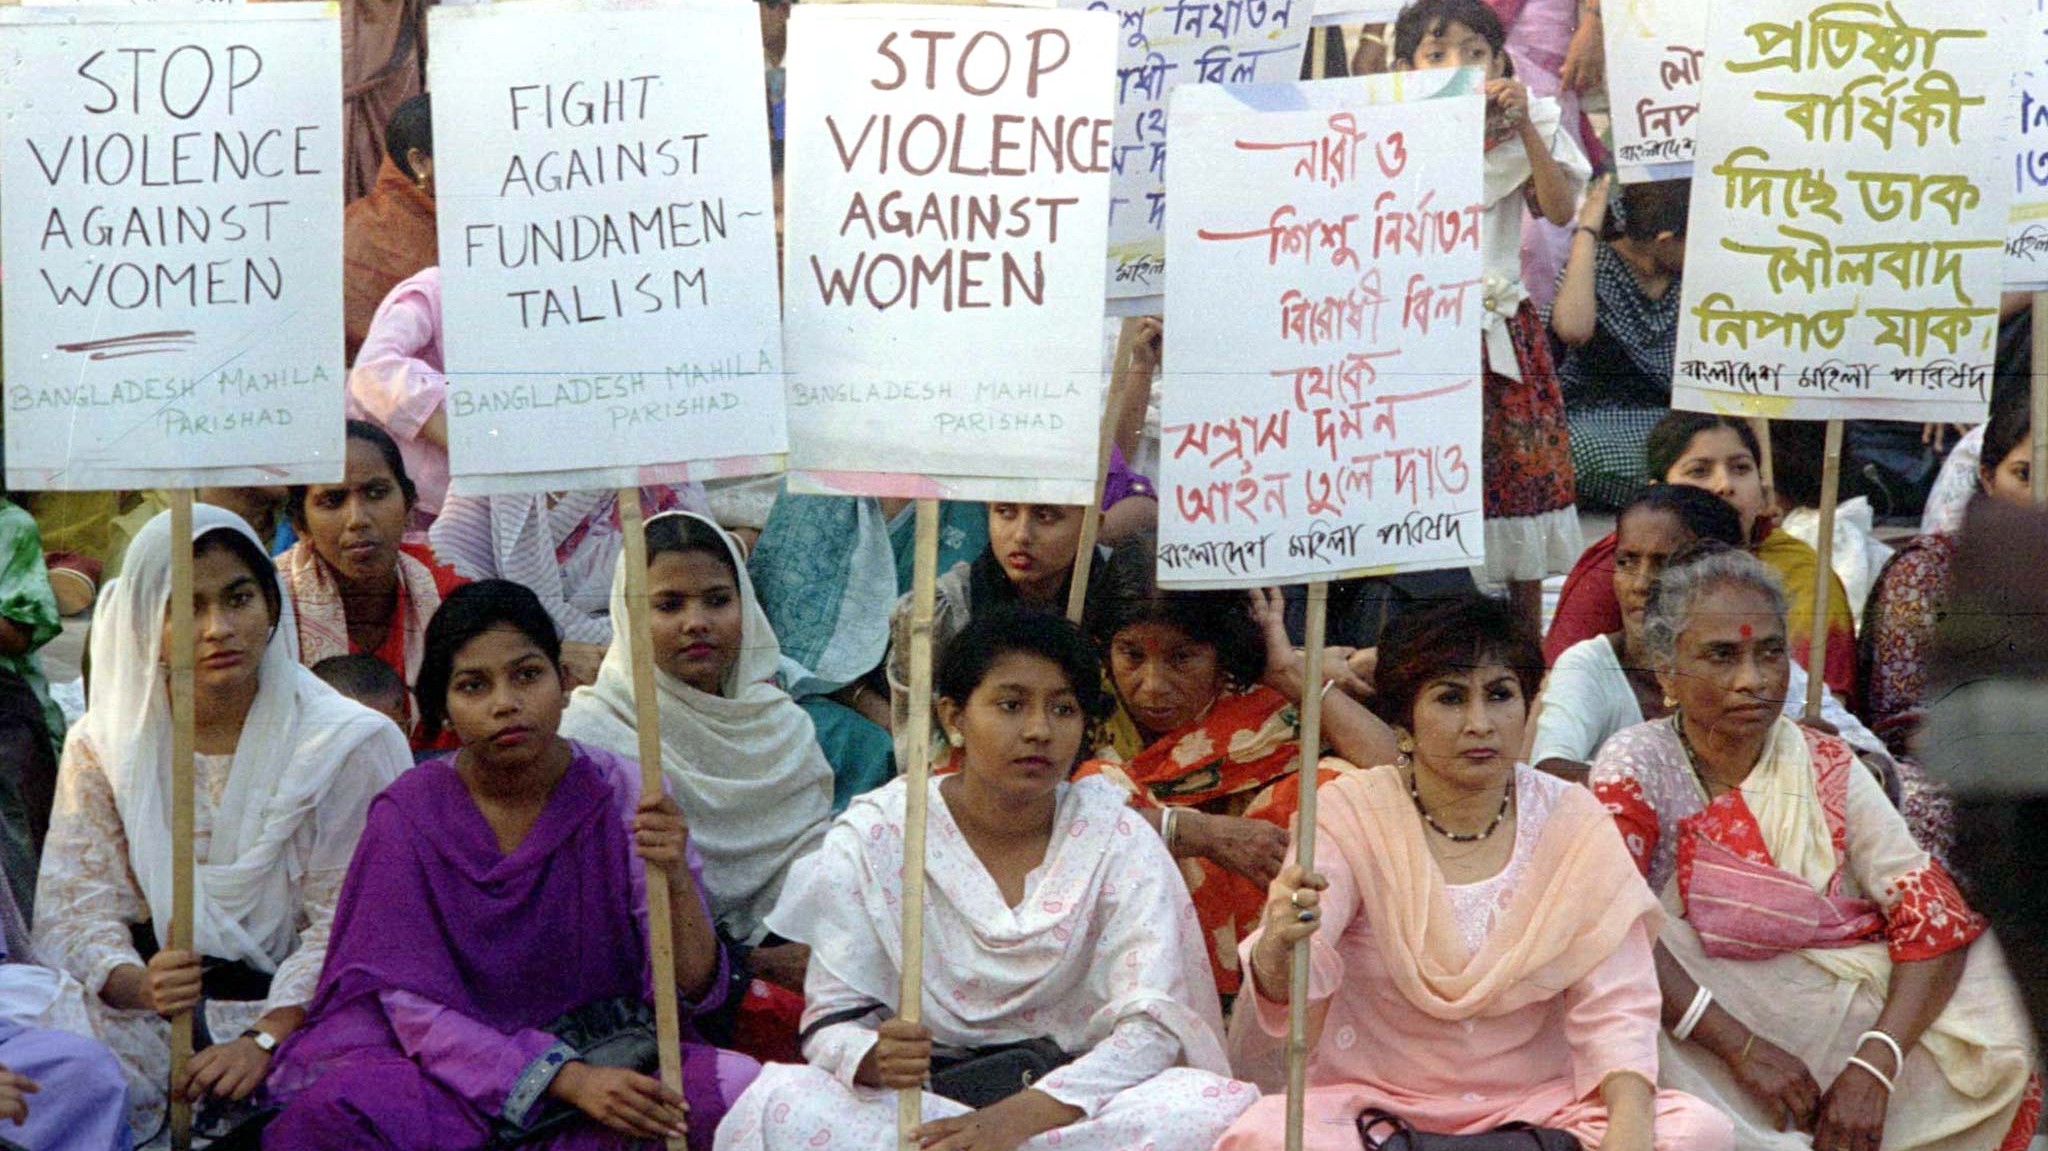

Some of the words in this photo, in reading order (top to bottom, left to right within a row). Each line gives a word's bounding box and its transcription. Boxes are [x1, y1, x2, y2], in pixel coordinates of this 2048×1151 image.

[869, 28, 1070, 98] STOP
[1725, 1, 1987, 73] প্রতিষ্ঠা
[78, 44, 262, 119] STOP
[509, 75, 661, 131] FIGHT
[1754, 69, 1985, 150] বার্ষিকী
[26, 126, 321, 186] VIOLENCE
[499, 133, 708, 197] AGAINST
[825, 113, 1112, 176] VIOLENCE
[1234, 112, 1367, 188] নারী
[1376, 131, 1408, 178] ও
[40, 200, 290, 250] AGAINST
[840, 190, 1079, 243] AGAINST
[1845, 170, 1981, 225] ডাক
[1197, 204, 1360, 271] শিশু
[1374, 189, 1488, 258] নির্যাতন
[40, 257, 282, 309] WOMEN
[809, 247, 1045, 312] WOMEN
[1720, 224, 2004, 307] মৌলবাদ
[507, 268, 708, 328] TALISM
[1280, 268, 1390, 345] বিরোধী
[1402, 273, 1484, 334] বিল
[1690, 292, 1858, 350] নিপাত
[9, 377, 197, 412] BANGLADESH
[217, 364, 329, 398] MAHILA
[453, 372, 648, 418] BANGLADESH
[666, 349, 773, 391] MAHILA
[792, 381, 952, 406] BANGLADESH
[975, 379, 1081, 402] MAHILA
[1270, 350, 1402, 412] থেকে
[1680, 360, 1787, 395] বাংলাদেশ
[1797, 359, 1880, 392] মহিলা
[157, 407, 294, 436] PARISHAD
[608, 391, 740, 432] PARISHAD
[933, 412, 1064, 435] PARISHAD
[1313, 379, 1473, 461] দমন
[1176, 459, 1291, 524] আইন
[1306, 454, 1382, 517] তুলে
[1384, 444, 1470, 506] দাও
[1158, 531, 1276, 576] বাংলাদেশ
[1288, 518, 1365, 564] মহিলা
